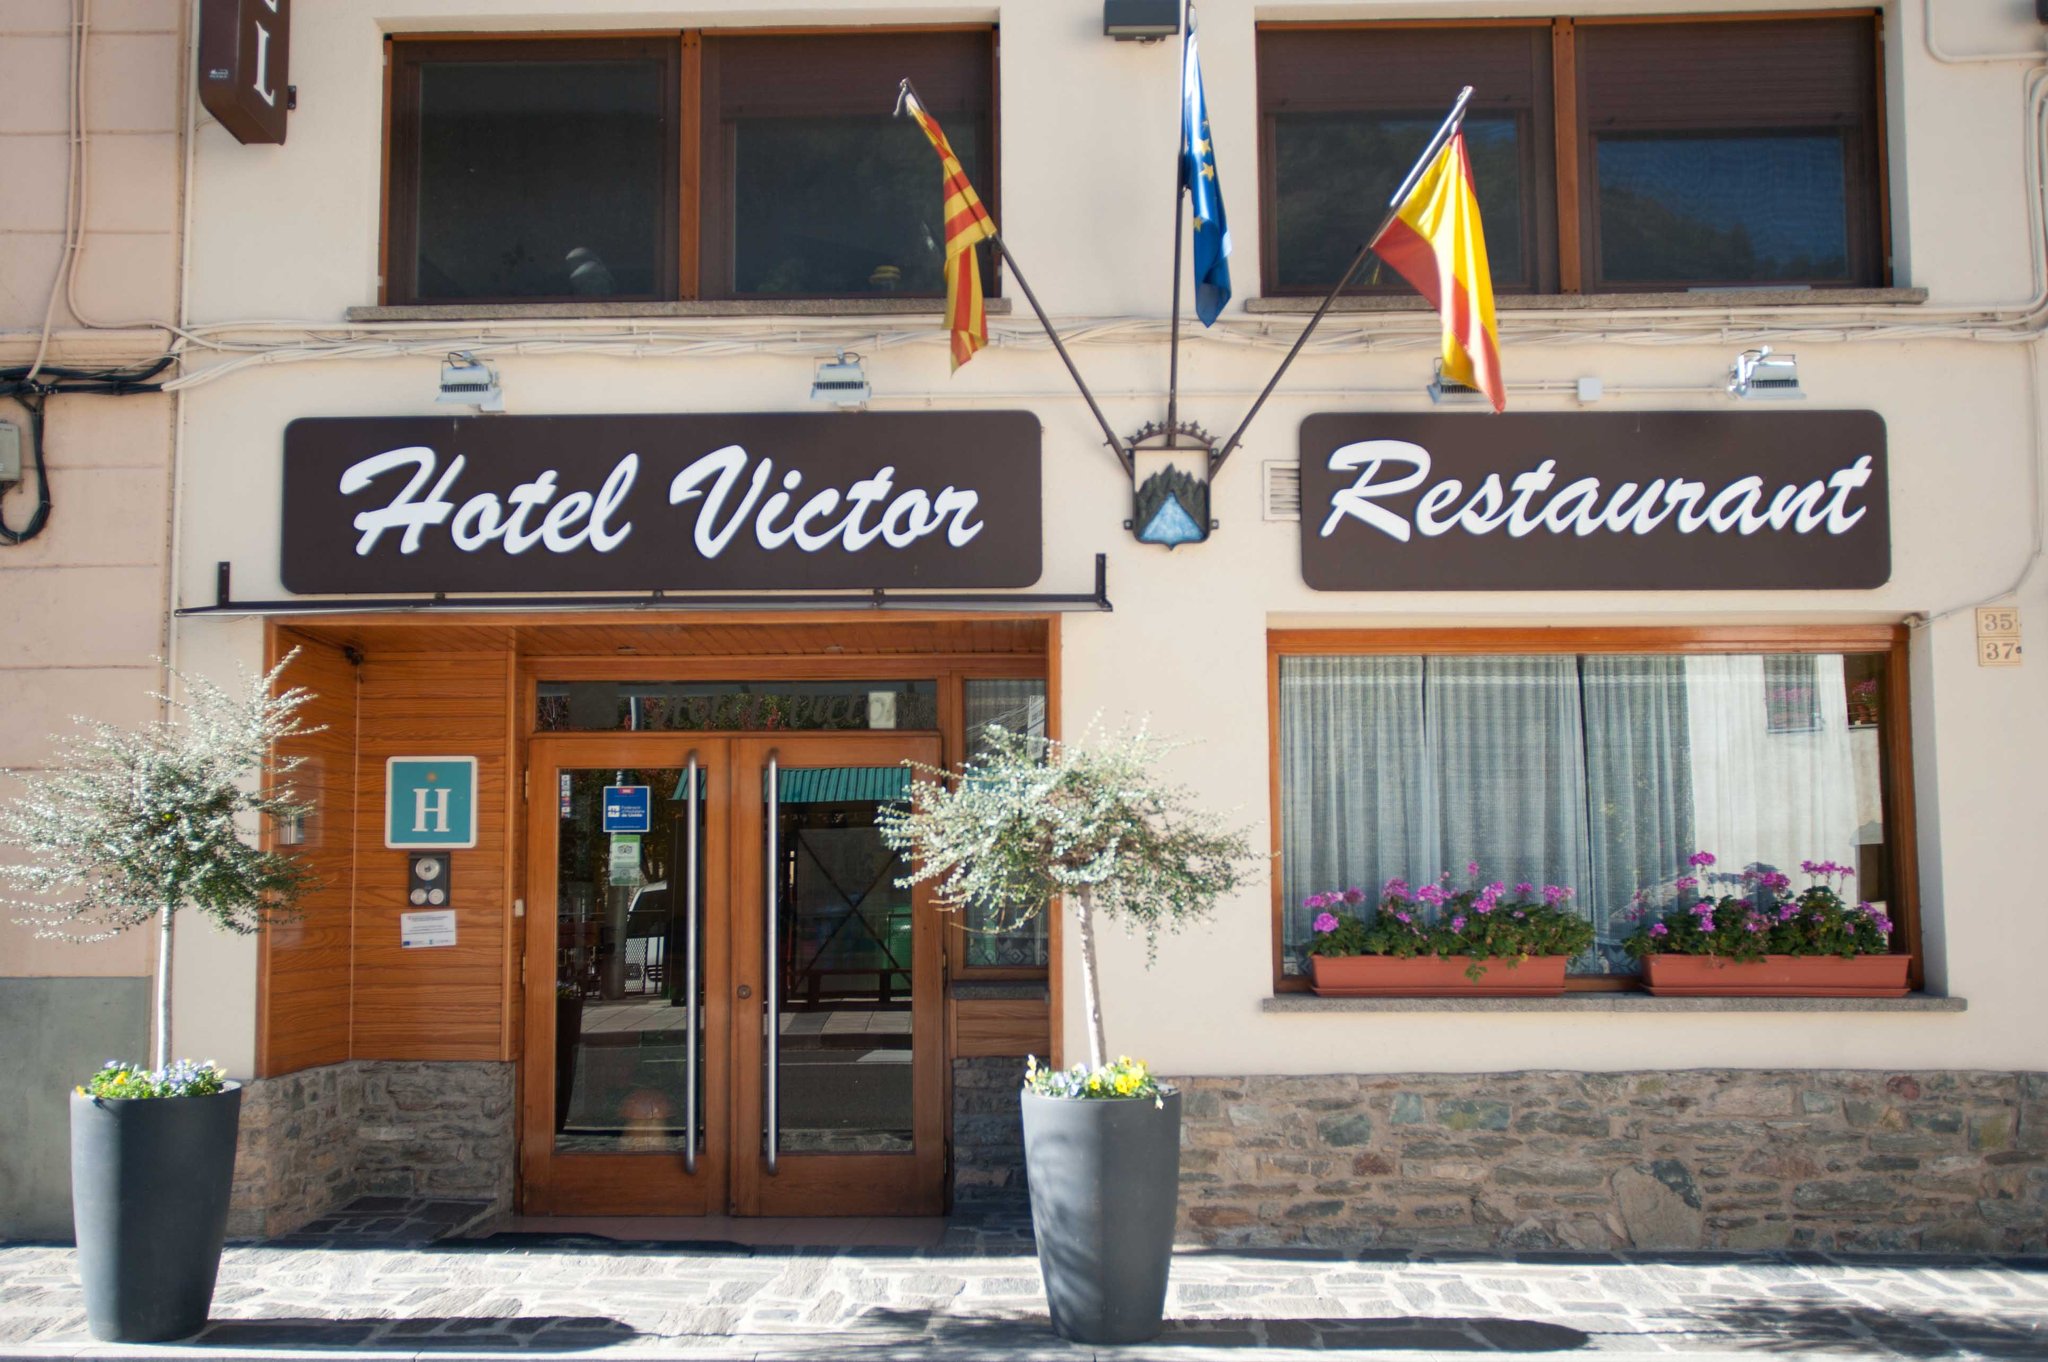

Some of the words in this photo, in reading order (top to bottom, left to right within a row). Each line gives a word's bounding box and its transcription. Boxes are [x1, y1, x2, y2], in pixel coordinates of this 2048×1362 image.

[253, 0, 278, 107] L
[340, 446, 638, 555] Hotel
[670, 445, 984, 558] Victor
[1321, 440, 1872, 542] Restaurant
[1985, 613, 2013, 631] 35
[1986, 642, 2016, 661] 37
[411, 788, 452, 832] H
